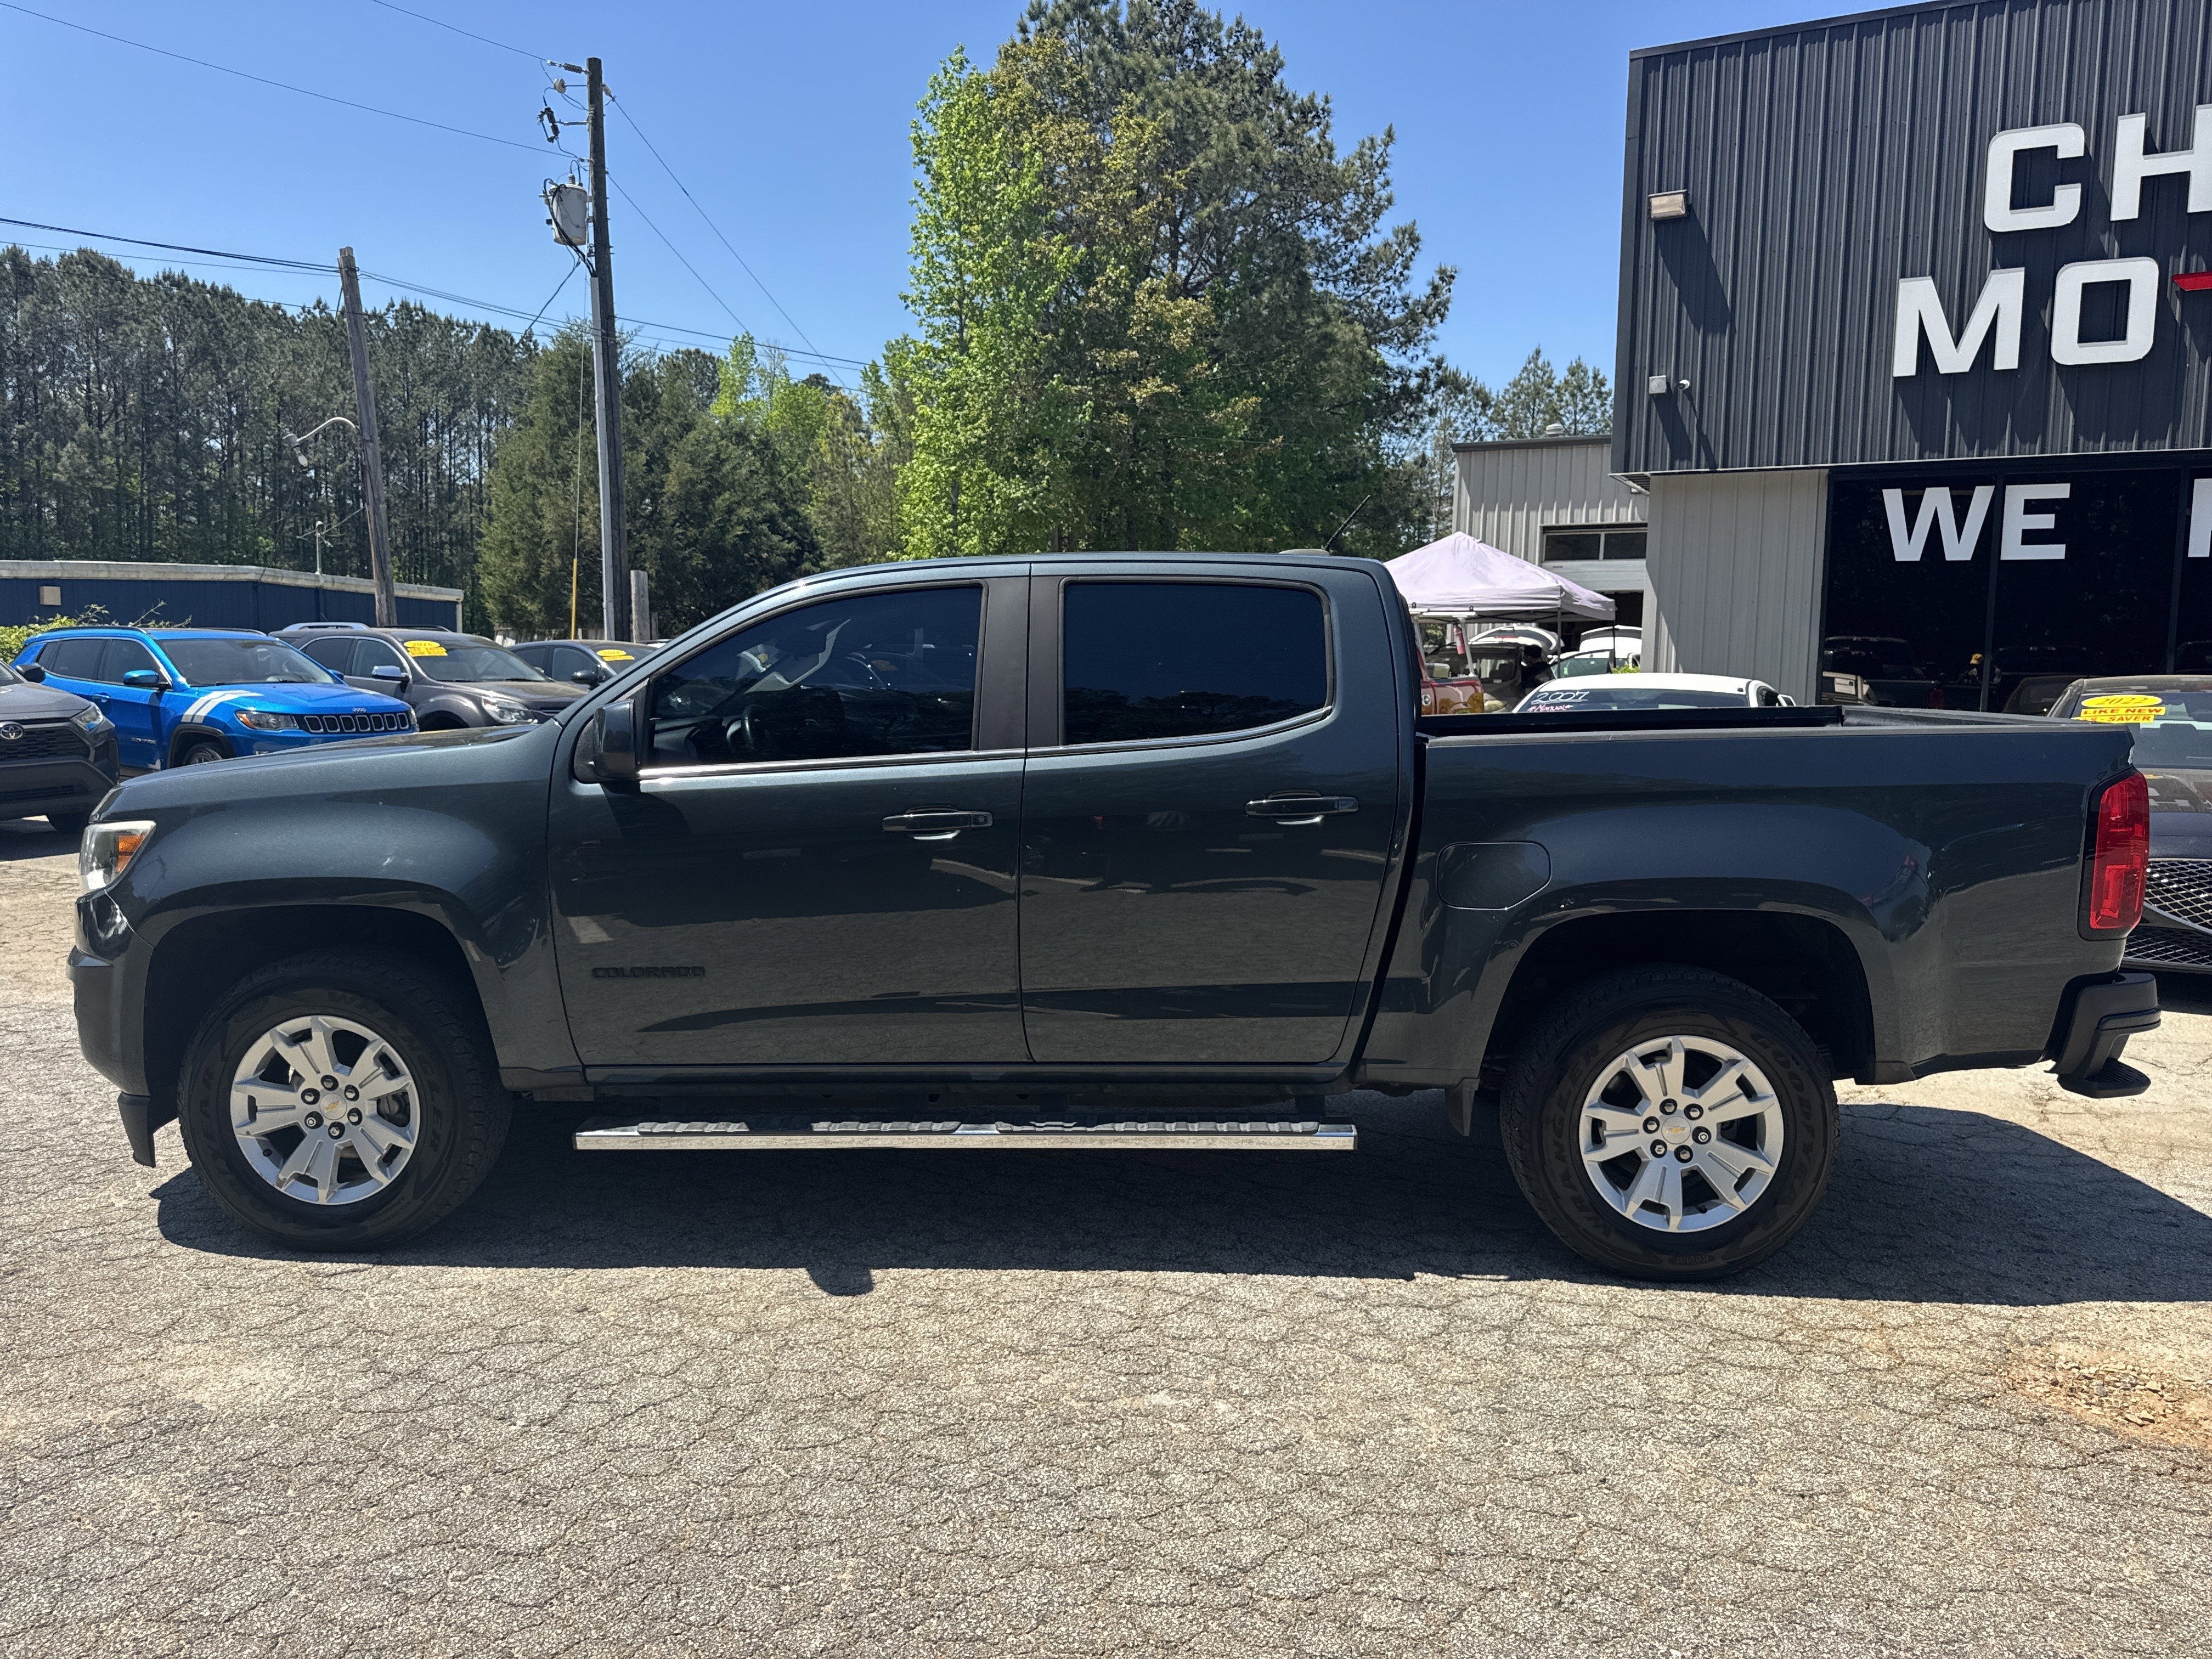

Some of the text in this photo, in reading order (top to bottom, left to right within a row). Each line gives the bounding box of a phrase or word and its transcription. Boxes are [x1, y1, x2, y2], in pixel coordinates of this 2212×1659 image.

[1882, 483, 2071, 562] WE
[1530, 691, 1590, 703] 2007
[2095, 697, 2149, 706] 2022
[592, 966, 706, 978] COLORADO
